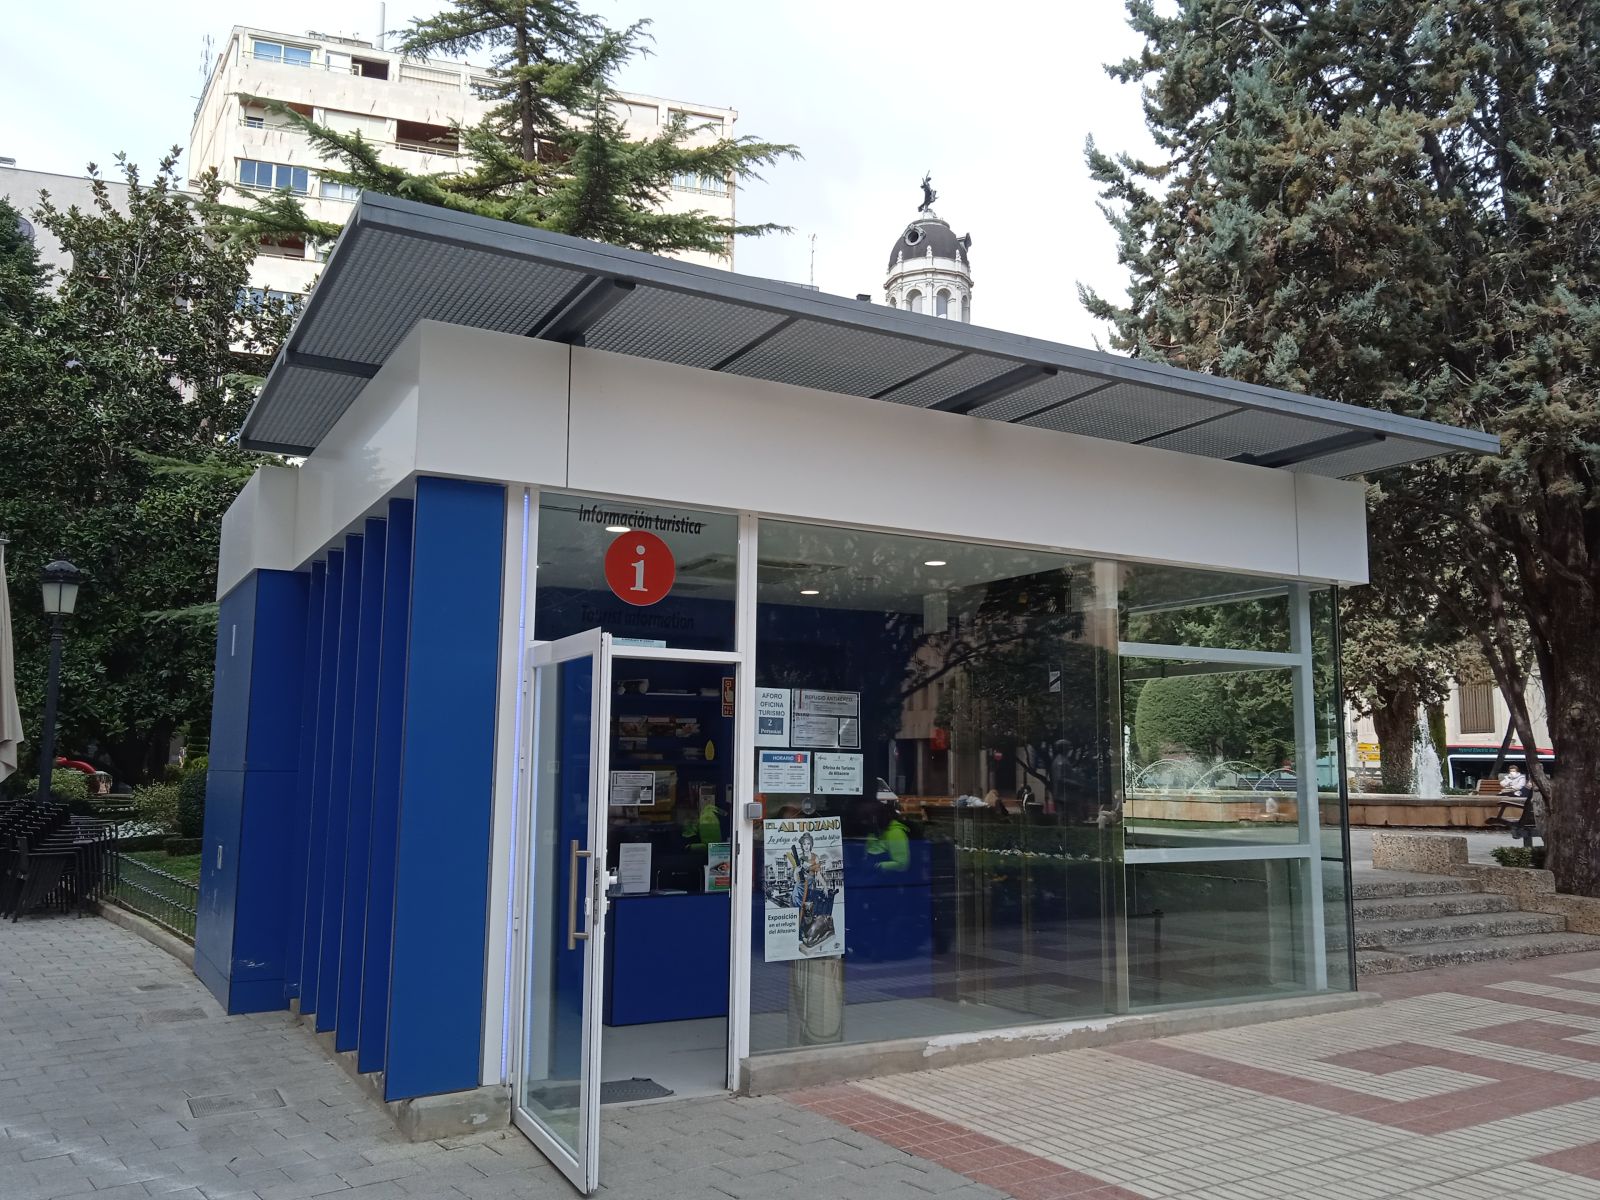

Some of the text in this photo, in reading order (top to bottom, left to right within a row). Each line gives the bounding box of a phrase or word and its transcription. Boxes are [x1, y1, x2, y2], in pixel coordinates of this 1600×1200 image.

[579, 504, 652, 529] Información
[630, 545, 648, 592] i
[581, 605, 695, 630] Tourist information
[762, 692, 782, 700] AFORO
[758, 709, 785, 717] TURISMO
[778, 818, 840, 833] ALTOZANO
[768, 912, 798, 922] Exposición
